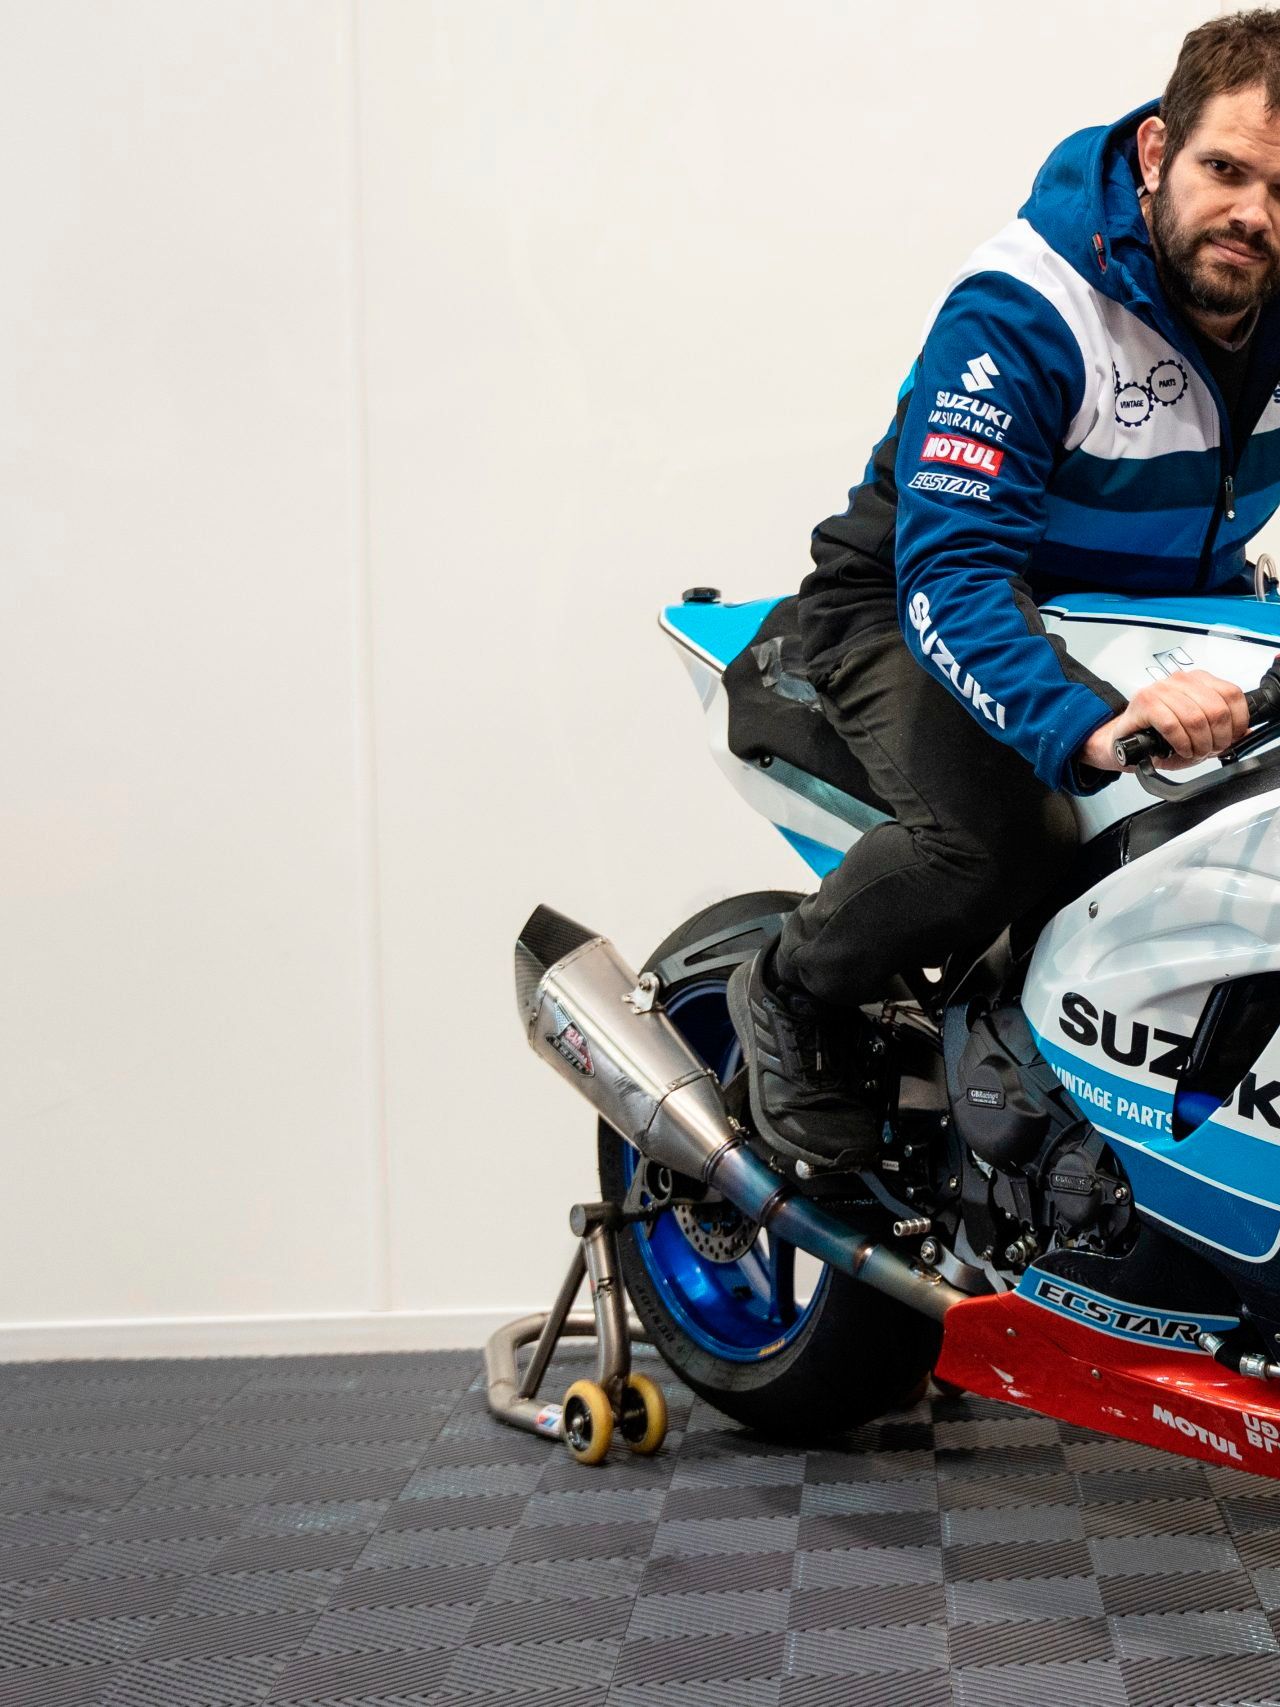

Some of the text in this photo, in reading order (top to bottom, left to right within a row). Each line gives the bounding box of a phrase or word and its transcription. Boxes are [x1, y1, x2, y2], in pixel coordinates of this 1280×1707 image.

[1158, 378, 1177, 388] PARTS
[935, 390, 1013, 431] SUZUKI
[1120, 399, 1144, 409] VINTAGE
[928, 410, 1006, 443] INSURANCE
[922, 436, 996, 472] MOTUL
[907, 471, 992, 502] ECSTAR
[908, 591, 1006, 730] SUZUKI
[1036, 1279, 1200, 1344] ECSTAR
[1152, 1403, 1243, 1461] MOTUL
